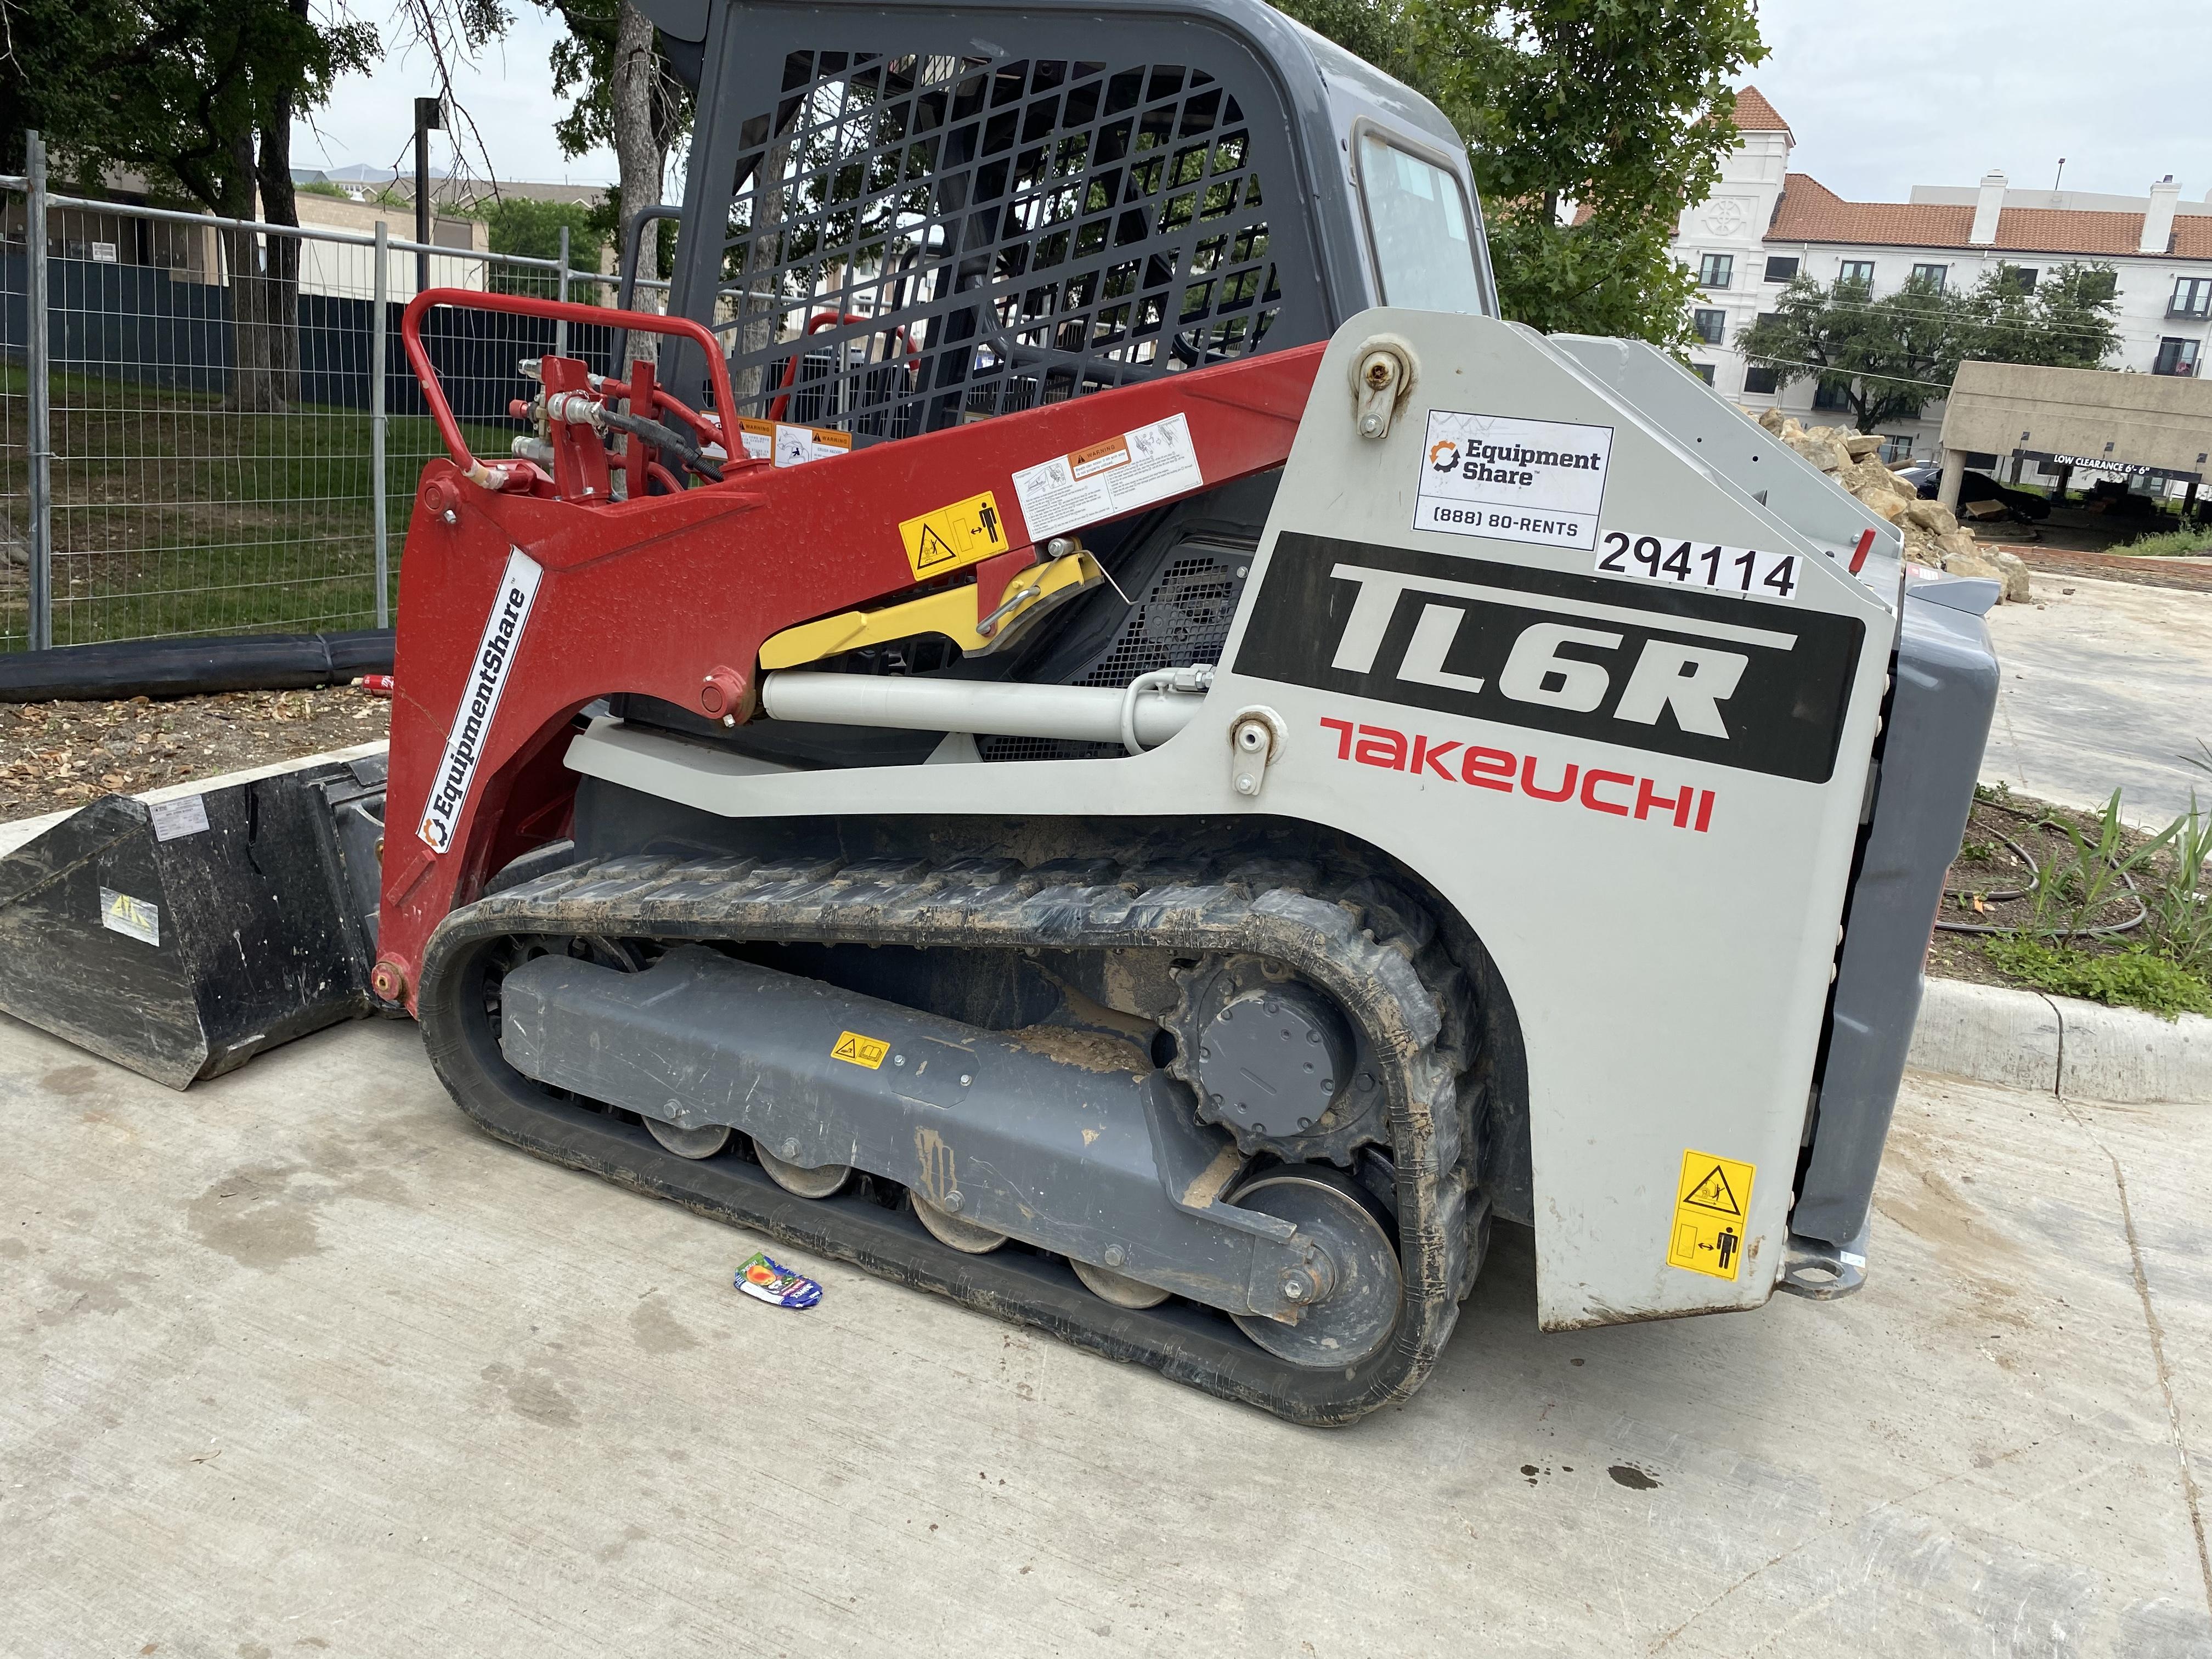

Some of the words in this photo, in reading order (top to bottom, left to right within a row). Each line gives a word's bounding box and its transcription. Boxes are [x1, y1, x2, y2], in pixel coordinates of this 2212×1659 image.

[1086, 444, 1115, 458] WARNING
[1465, 439, 1601, 471] Equipment
[2053, 454, 2074, 464] LOW
[2075, 458, 2124, 471] CLEARANCE
[1462, 461, 1533, 486] Share
[1434, 506, 1482, 526] (888)
[1488, 514, 1578, 537] 80-RENTS
[1600, 531, 1795, 597] 294114
[1329, 562, 1798, 740] TL6R
[433, 588, 525, 820] EquipmentShare
